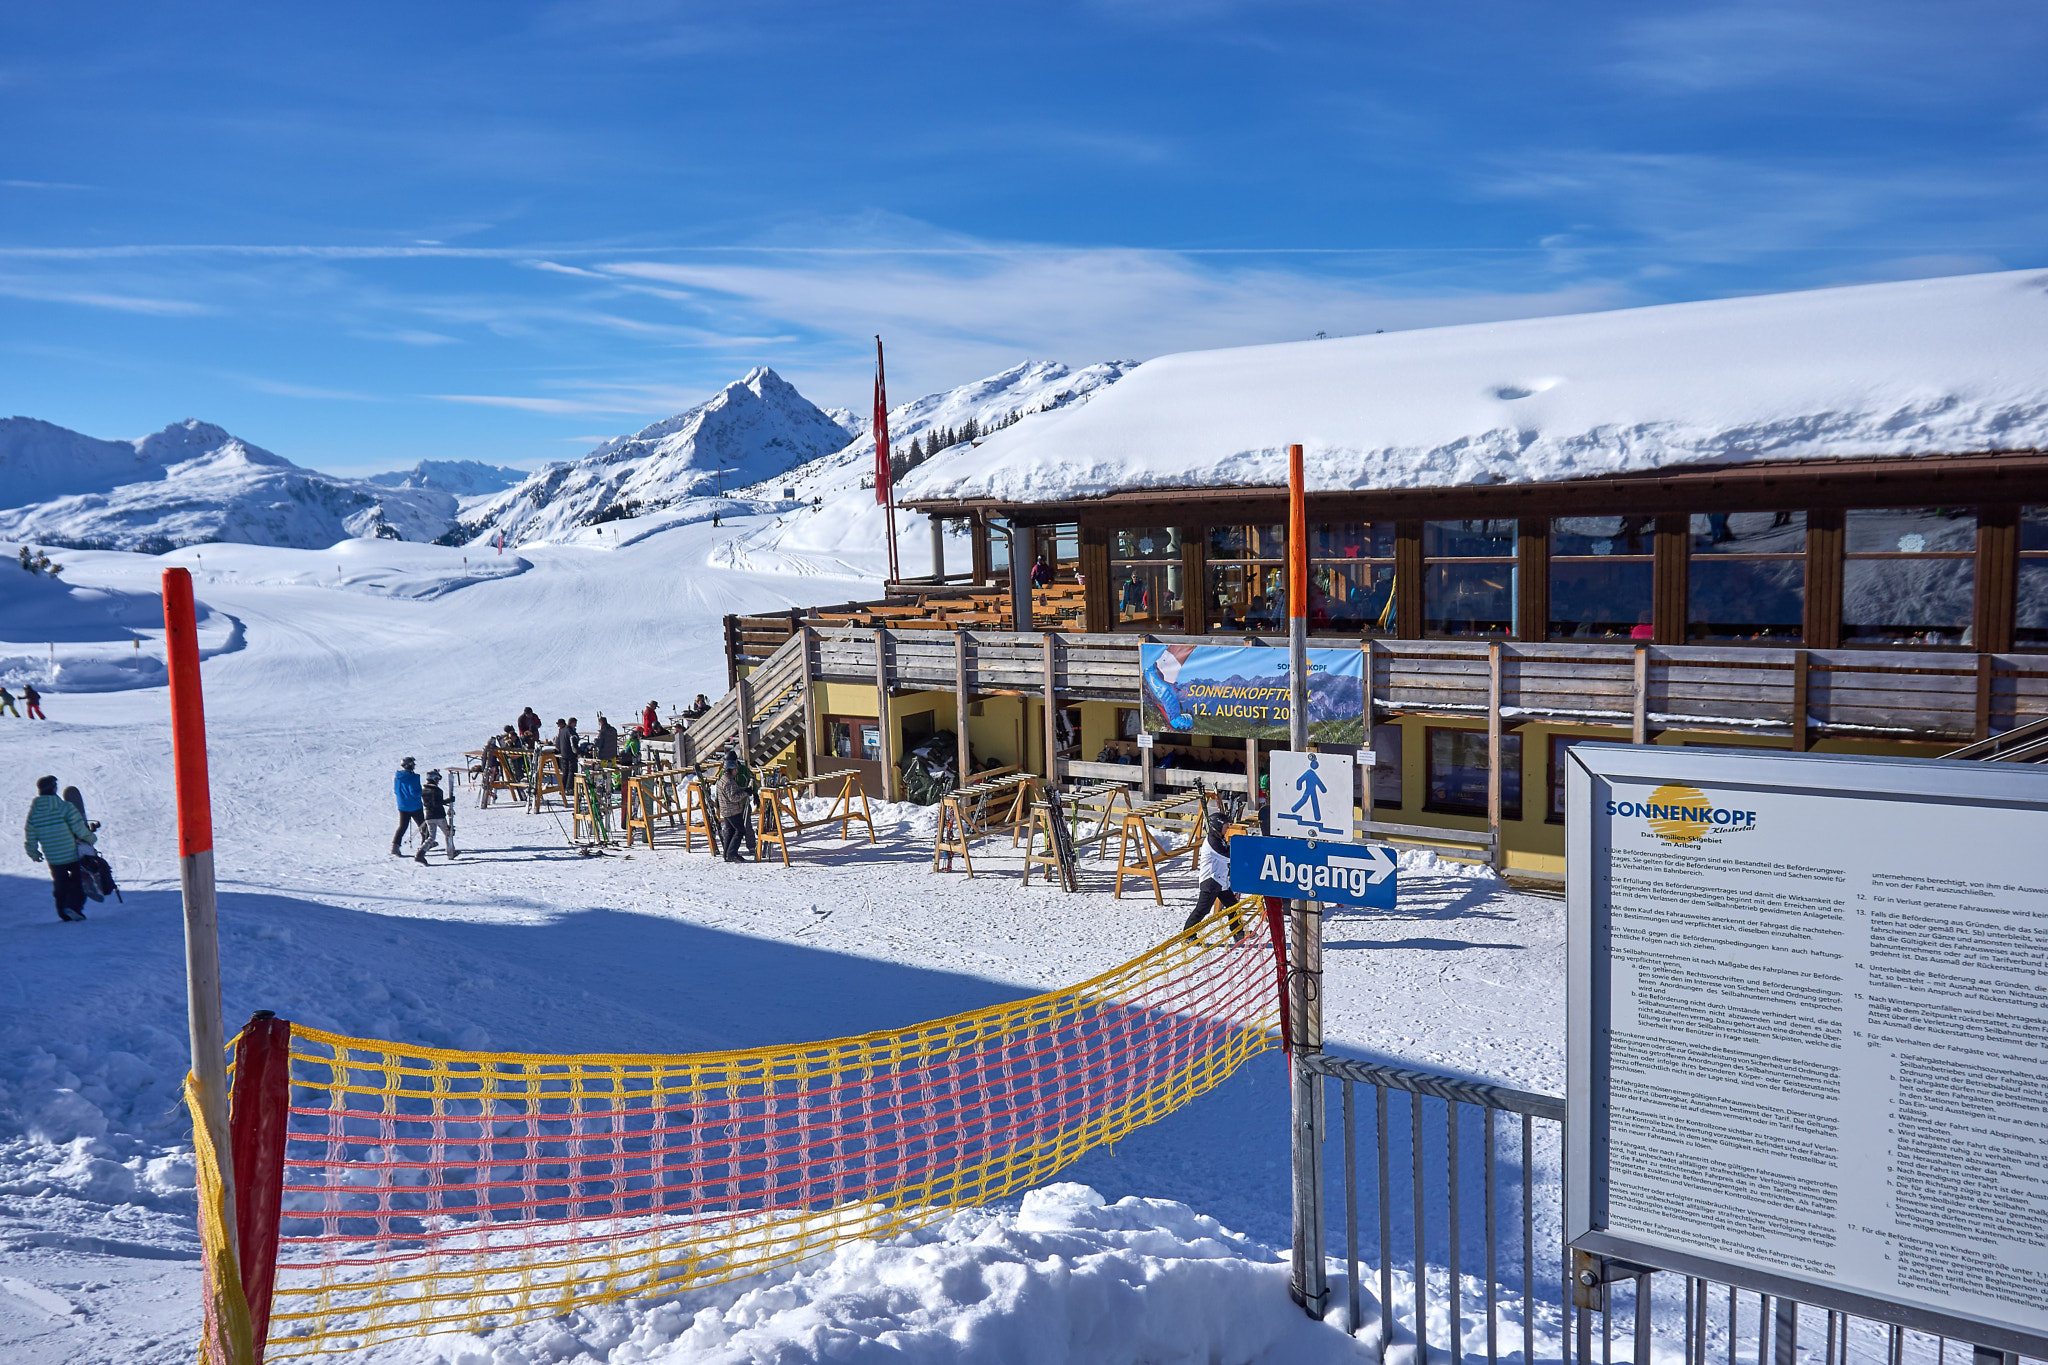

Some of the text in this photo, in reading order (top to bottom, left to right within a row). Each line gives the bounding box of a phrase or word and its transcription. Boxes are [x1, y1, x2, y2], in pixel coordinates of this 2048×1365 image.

[1277, 663, 1328, 672] SOKOPF
[1188, 684, 1312, 702] SONNENKOPFTRL
[1192, 703, 1212, 716] 12.
[1216, 704, 1268, 718] AUGUST
[1606, 800, 1756, 826] SONNENKOPF
[1656, 832, 1722, 844] Familien-Skigebiet
[1709, 824, 1756, 834] Klostertal
[1674, 841, 1702, 850] Arlberg
[1259, 854, 1366, 898] Abgang
[1872, 873, 1925, 883] unternehmens
[1914, 883, 1935, 892] Fahrt
[1895, 897, 1922, 906] Verlust
[1922, 901, 1958, 910] geratene
[1958, 903, 2011, 915] Fahrausweise
[1870, 910, 1887, 918] Falls
[1901, 913, 1949, 926] Beförderung
[1870, 918, 1894, 926] treten
[1927, 925, 1954, 933] gemäß
[1972, 929, 1985, 937] 5b)
[1869, 950, 1901, 958] gedehnt
[1929, 956, 1960, 966] Ausmaß
[1976, 961, 2036, 976] Rückerstattung
[1869, 964, 1911, 975] Unterbleibt
[1928, 971, 1976, 985] Beförderung
[1868, 980, 1902, 989] tunfällen
[1909, 984, 1926, 992] kein
[1927, 987, 1963, 997] Anspruch
[1978, 993, 2038, 1009] Rückerstattung
[1868, 994, 1887, 1003] Nach
[1982, 1010, 1994, 1018] bei
[1882, 1019, 1912, 1030] Ausmaß
[1927, 1026, 1985, 1041] Rückerstattung
[1986, 1034, 2023, 1046] bestimmt
[1894, 1036, 1931, 1048] Verhalten
[1947, 1044, 1984, 1056] Fahrgäste
[2002, 1054, 2038, 1064] während
[1899, 1083, 1914, 1091] heit
[1934, 1089, 1950, 1097] den
[1951, 1091, 1994, 1104] Fahrgästen
[1995, 1100, 2040, 1112] geöffneten
[1907, 1092, 1923, 1100] den
[1923, 1094, 1960, 1106] Stationen
[1897, 1113, 1932, 1125] Während
[1949, 1122, 1969, 1132] Fahrt
[1971, 1126, 1987, 1134] sind
[1897, 1151, 2039, 1183] Das Heraushalten oder das Abwerfen
[1895, 1196, 1929, 1208] Hinweise
[1929, 1203, 1945, 1212] sind
[1946, 1207, 1994, 1221] genauestens
[1895, 1218, 1911, 1227] bine
[1912, 1223, 1967, 1239] mitgenommen
[1874, 1229, 1886, 1237] die
[1887, 1231, 1934, 1248] Beförderung
[1950, 1245, 1981, 1257] Kindern
[1981, 1252, 1997, 1260] gilt:
[1897, 1278, 1915, 1288] Lage
